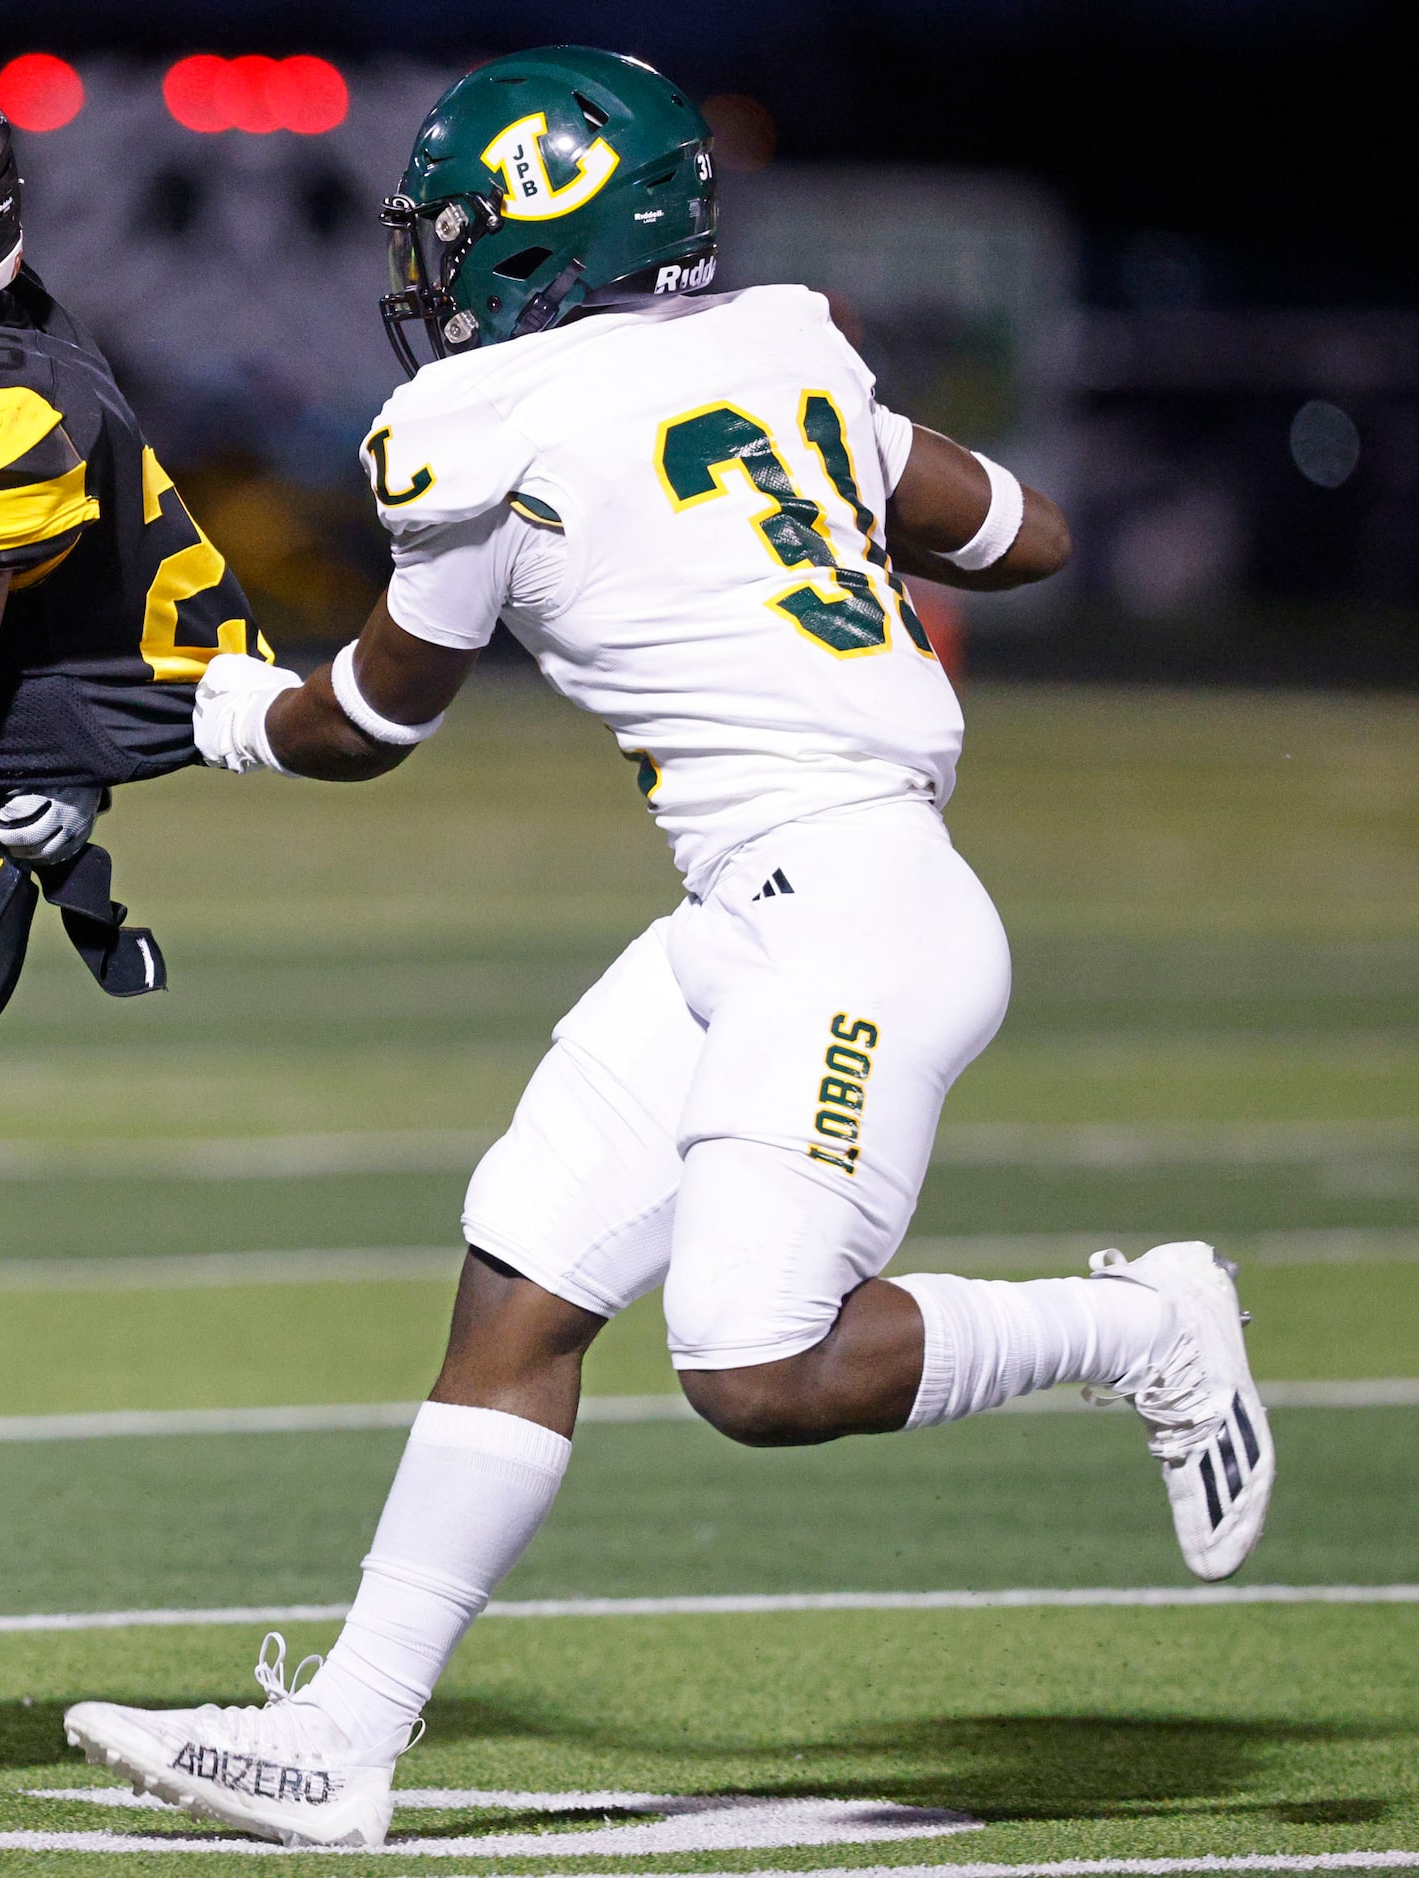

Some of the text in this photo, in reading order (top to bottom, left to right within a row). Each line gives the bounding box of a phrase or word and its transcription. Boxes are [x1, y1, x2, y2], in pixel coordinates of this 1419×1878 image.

[480, 111, 621, 222] L
[696, 153, 713, 181] 31
[652, 388, 938, 661] 31
[806, 1010, 882, 1178] LOBOS
